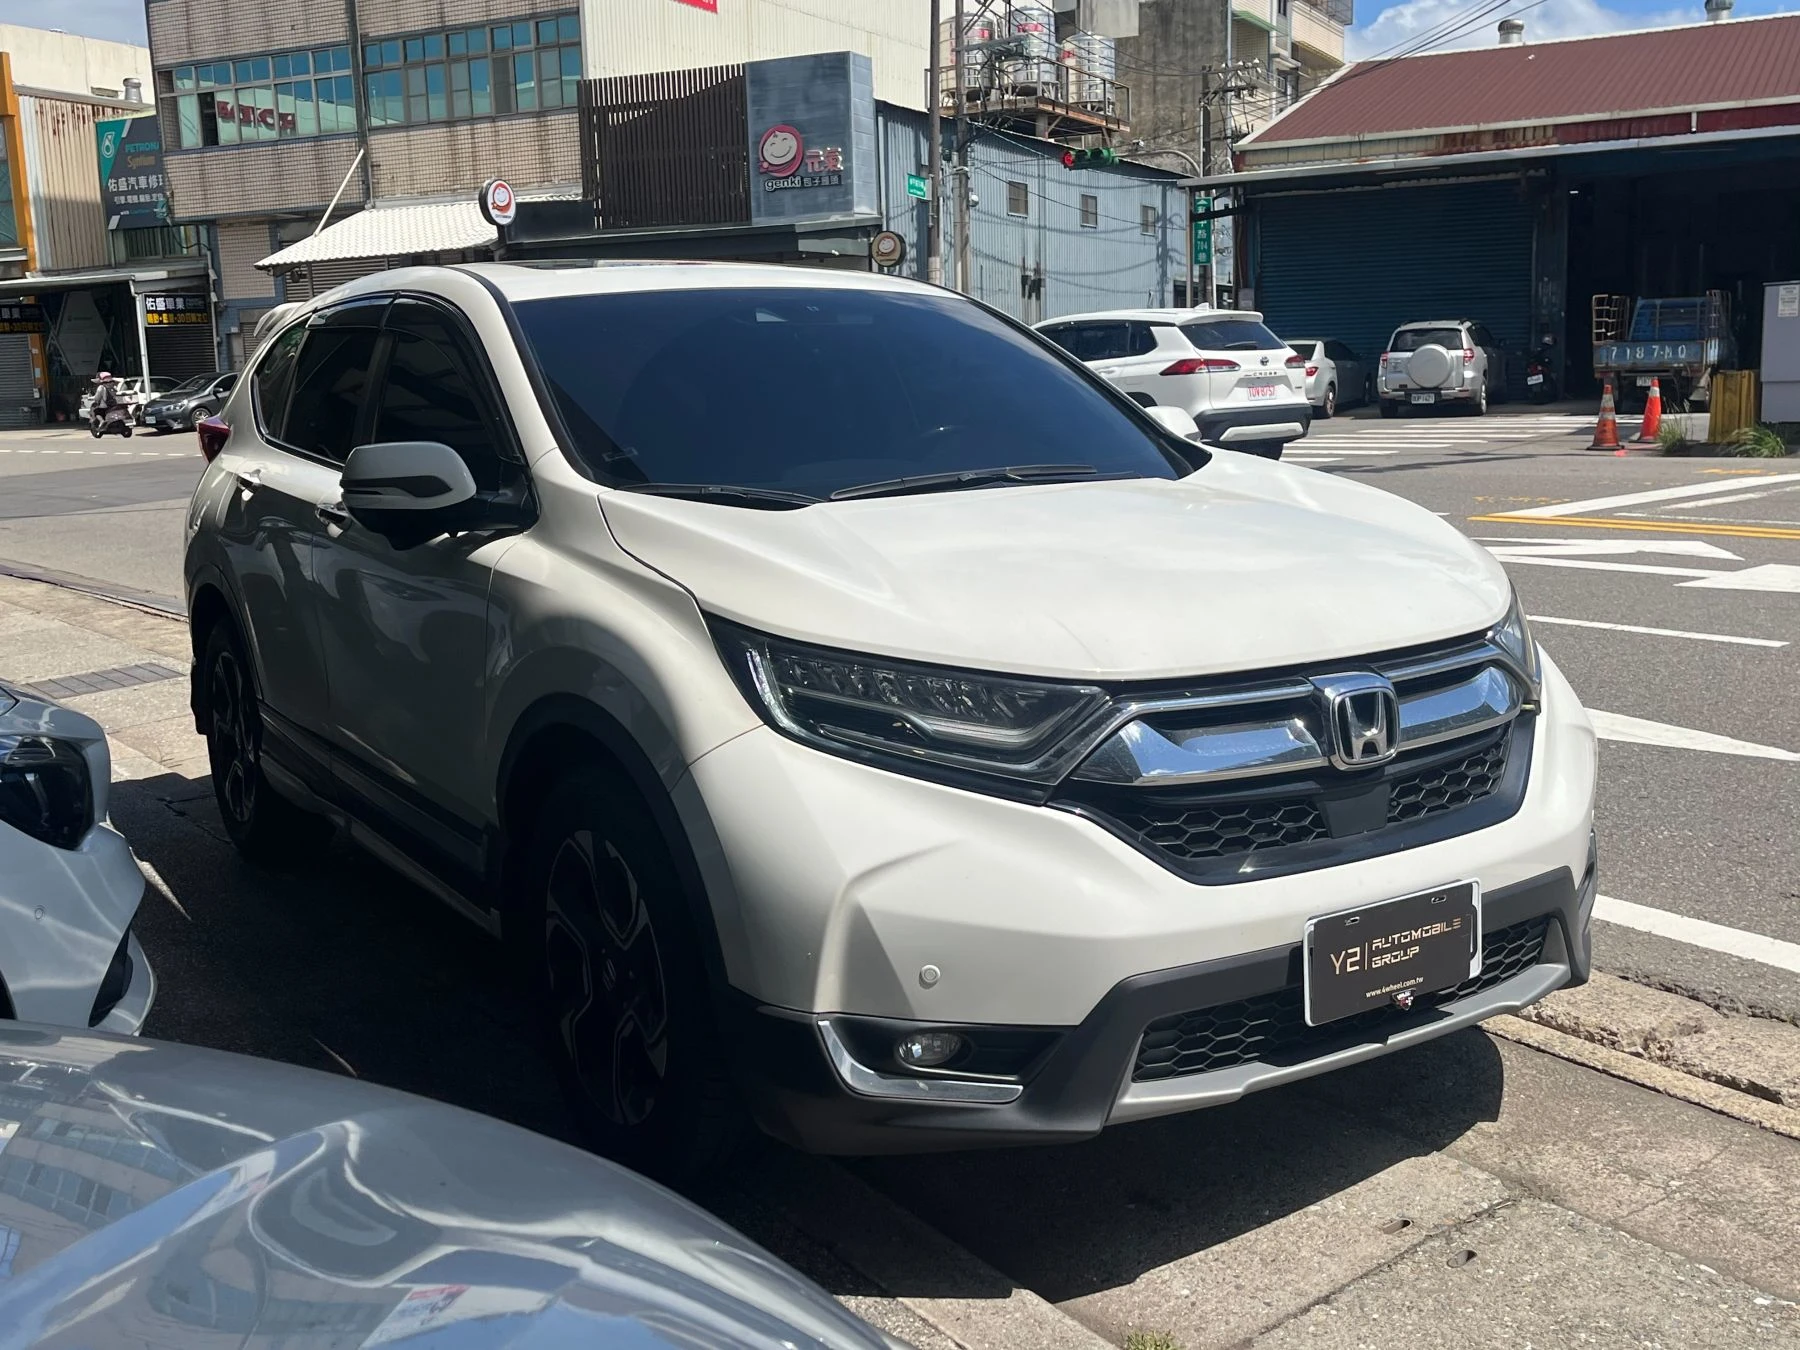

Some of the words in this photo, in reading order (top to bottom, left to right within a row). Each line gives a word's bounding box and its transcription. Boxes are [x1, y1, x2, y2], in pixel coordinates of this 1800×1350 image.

[126, 142, 159, 153] PETRON
[765, 176, 801, 191] genki
[1372, 918, 1461, 951] AUTOMOBILE
[1372, 946, 1420, 969] GROUP
[1365, 976, 1424, 998] www.4wheel.com.tw
